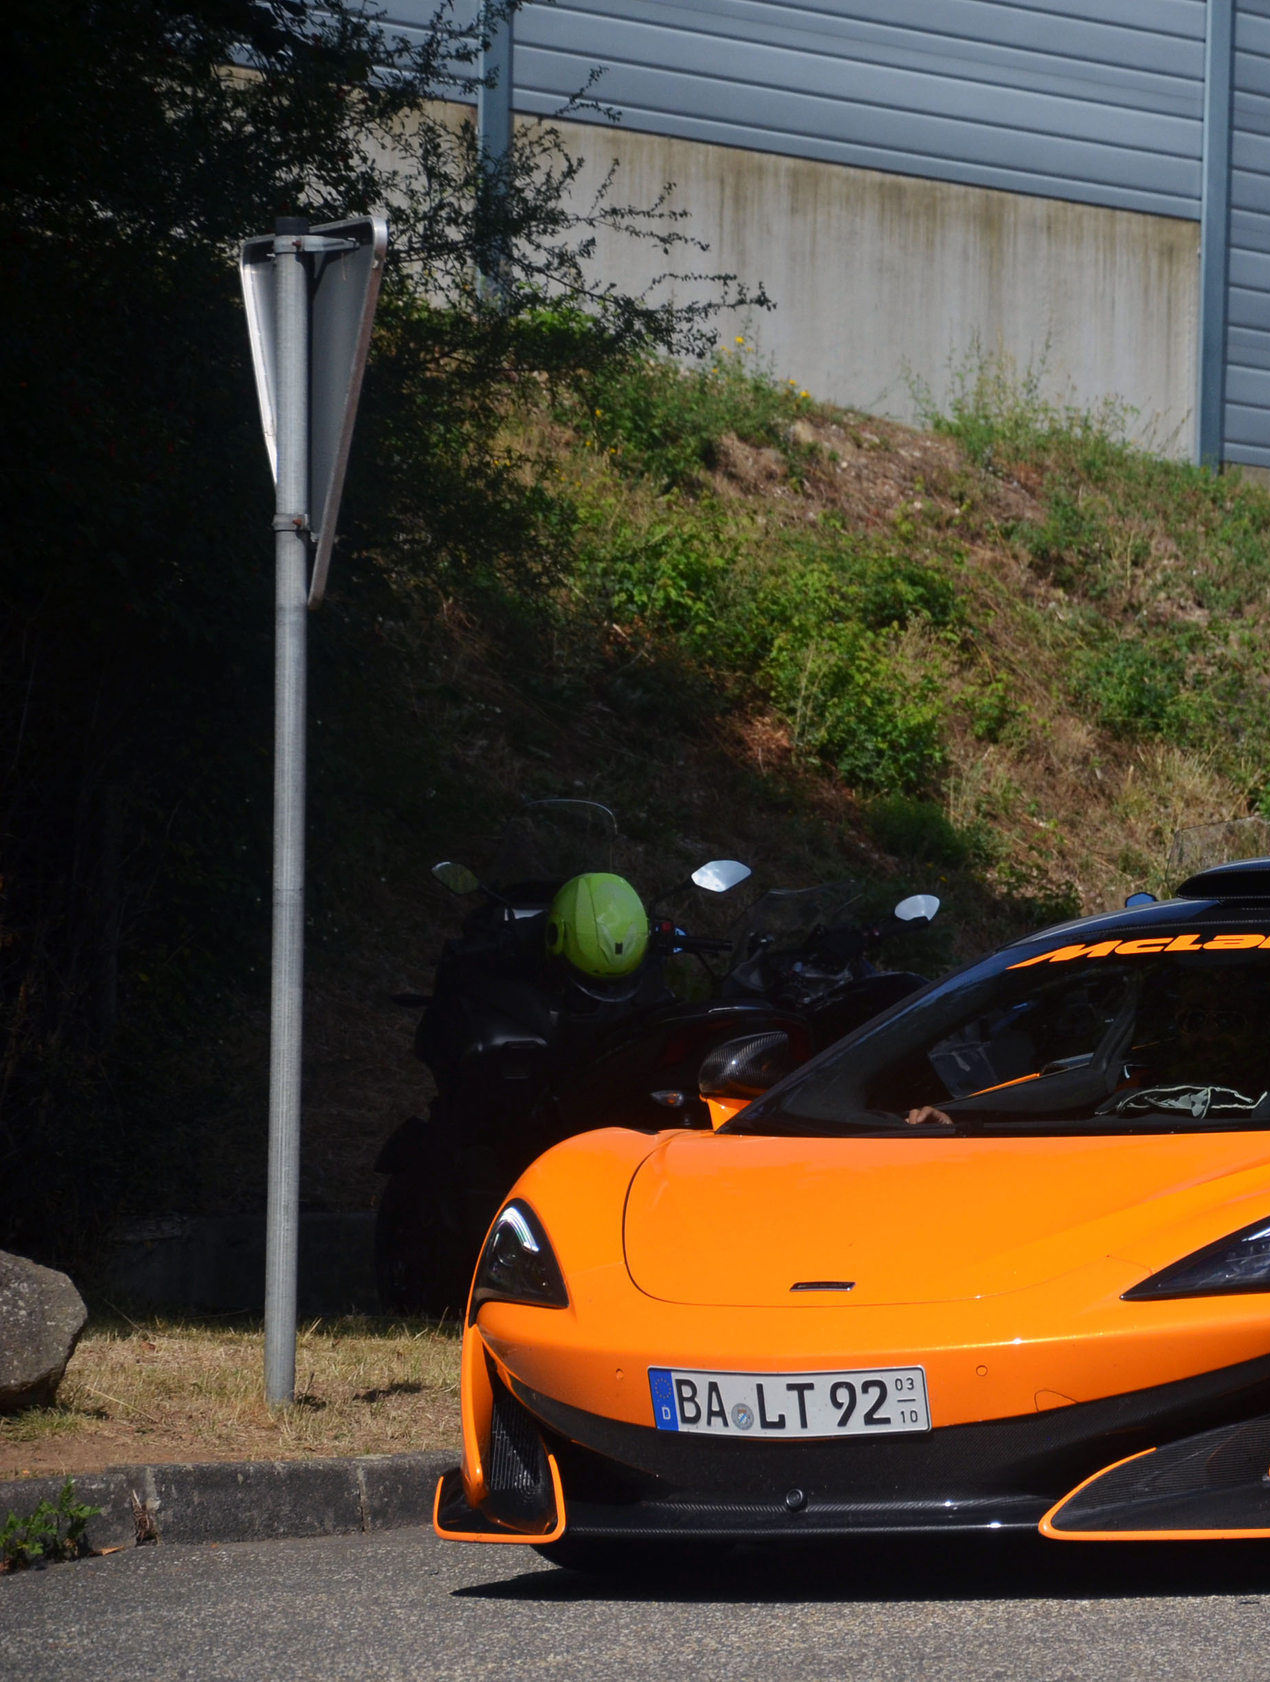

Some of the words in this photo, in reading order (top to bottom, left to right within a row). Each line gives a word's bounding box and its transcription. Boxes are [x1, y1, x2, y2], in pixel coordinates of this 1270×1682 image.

[894, 1377, 915, 1392] 03
[674, 1378, 729, 1428] BA
[756, 1382, 815, 1430] LT
[829, 1379, 892, 1427] 92
[661, 1406, 671, 1420] D
[900, 1410, 919, 1424] 10
